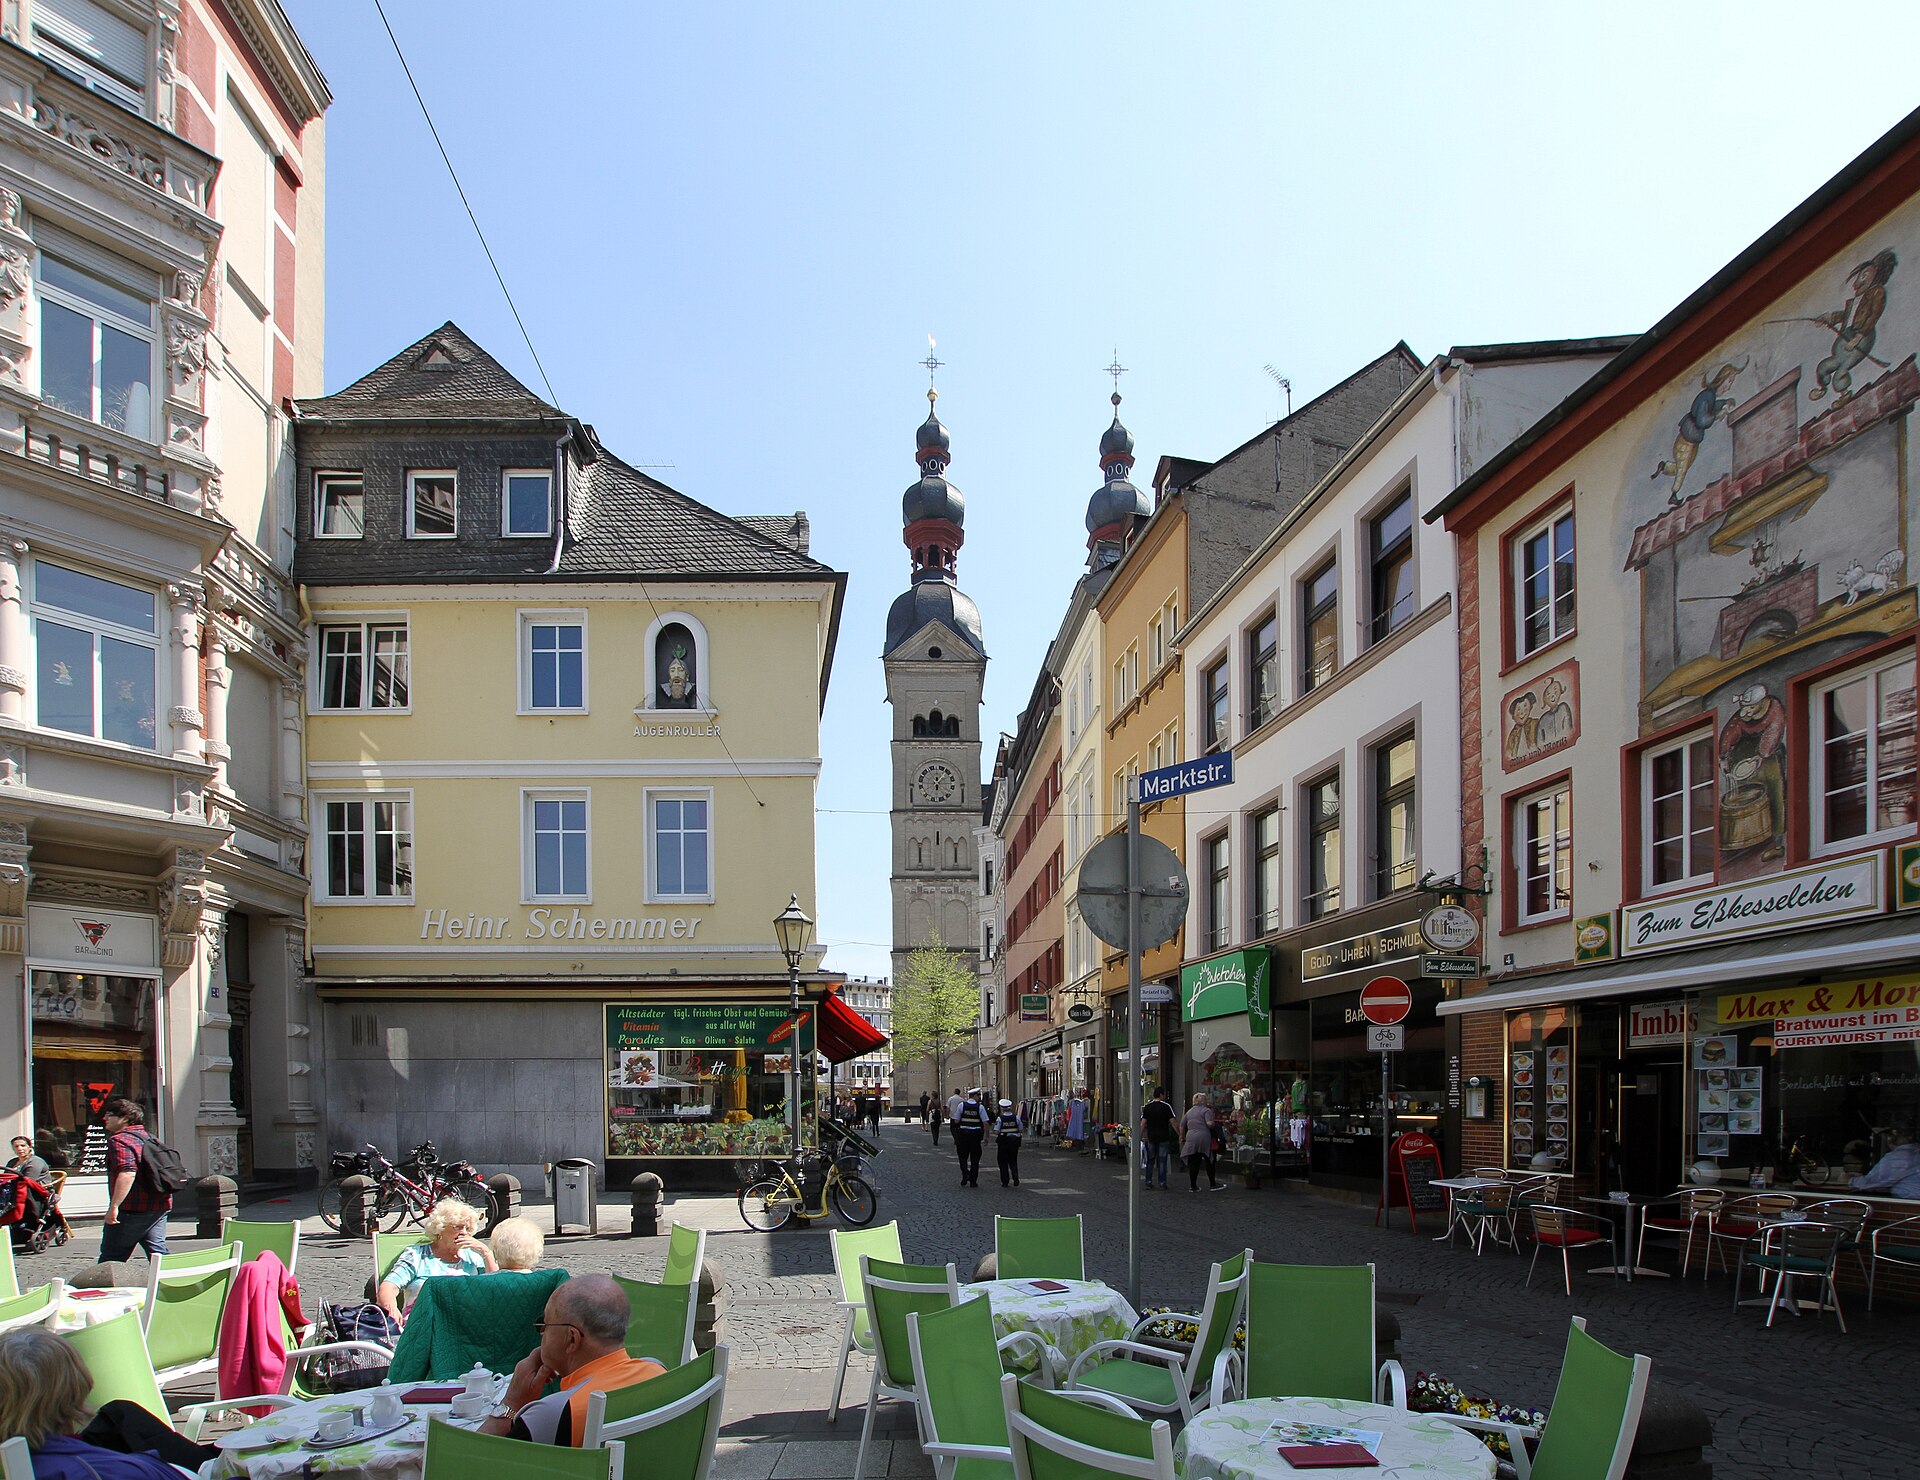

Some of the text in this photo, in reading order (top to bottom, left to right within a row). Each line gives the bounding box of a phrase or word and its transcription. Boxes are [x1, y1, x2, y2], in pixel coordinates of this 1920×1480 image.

[633, 725, 721, 737] AUGENROLLER
[1144, 763, 1227, 798] Marktstr.
[1636, 875, 1856, 945] Zum Eßkesselchen
[420, 908, 702, 940] Heinr. Schemmer
[1431, 918, 1473, 941] Bitburger
[1310, 931, 1424, 970] GOLD UHREN SCHMUC
[1425, 960, 1438, 973] Zum
[1726, 996, 1795, 1020] Max
[1806, 987, 1834, 1012] &
[618, 1008, 666, 1018] Altstädter
[673, 1008, 788, 1020] tägl. frisches Obst und Gemüse
[1345, 1008, 1366, 1023] BAR
[1775, 1007, 1920, 1033] Bratwurst im B
[623, 1022, 660, 1031] Vitamin
[705, 1021, 756, 1030] aus aller Welt
[618, 1034, 665, 1045] Paradies
[680, 1035, 756, 1045] Käse Oliven Salate
[1775, 1028, 1920, 1047] CURRYWURST mit
[683, 1055, 753, 1082] Bottega
